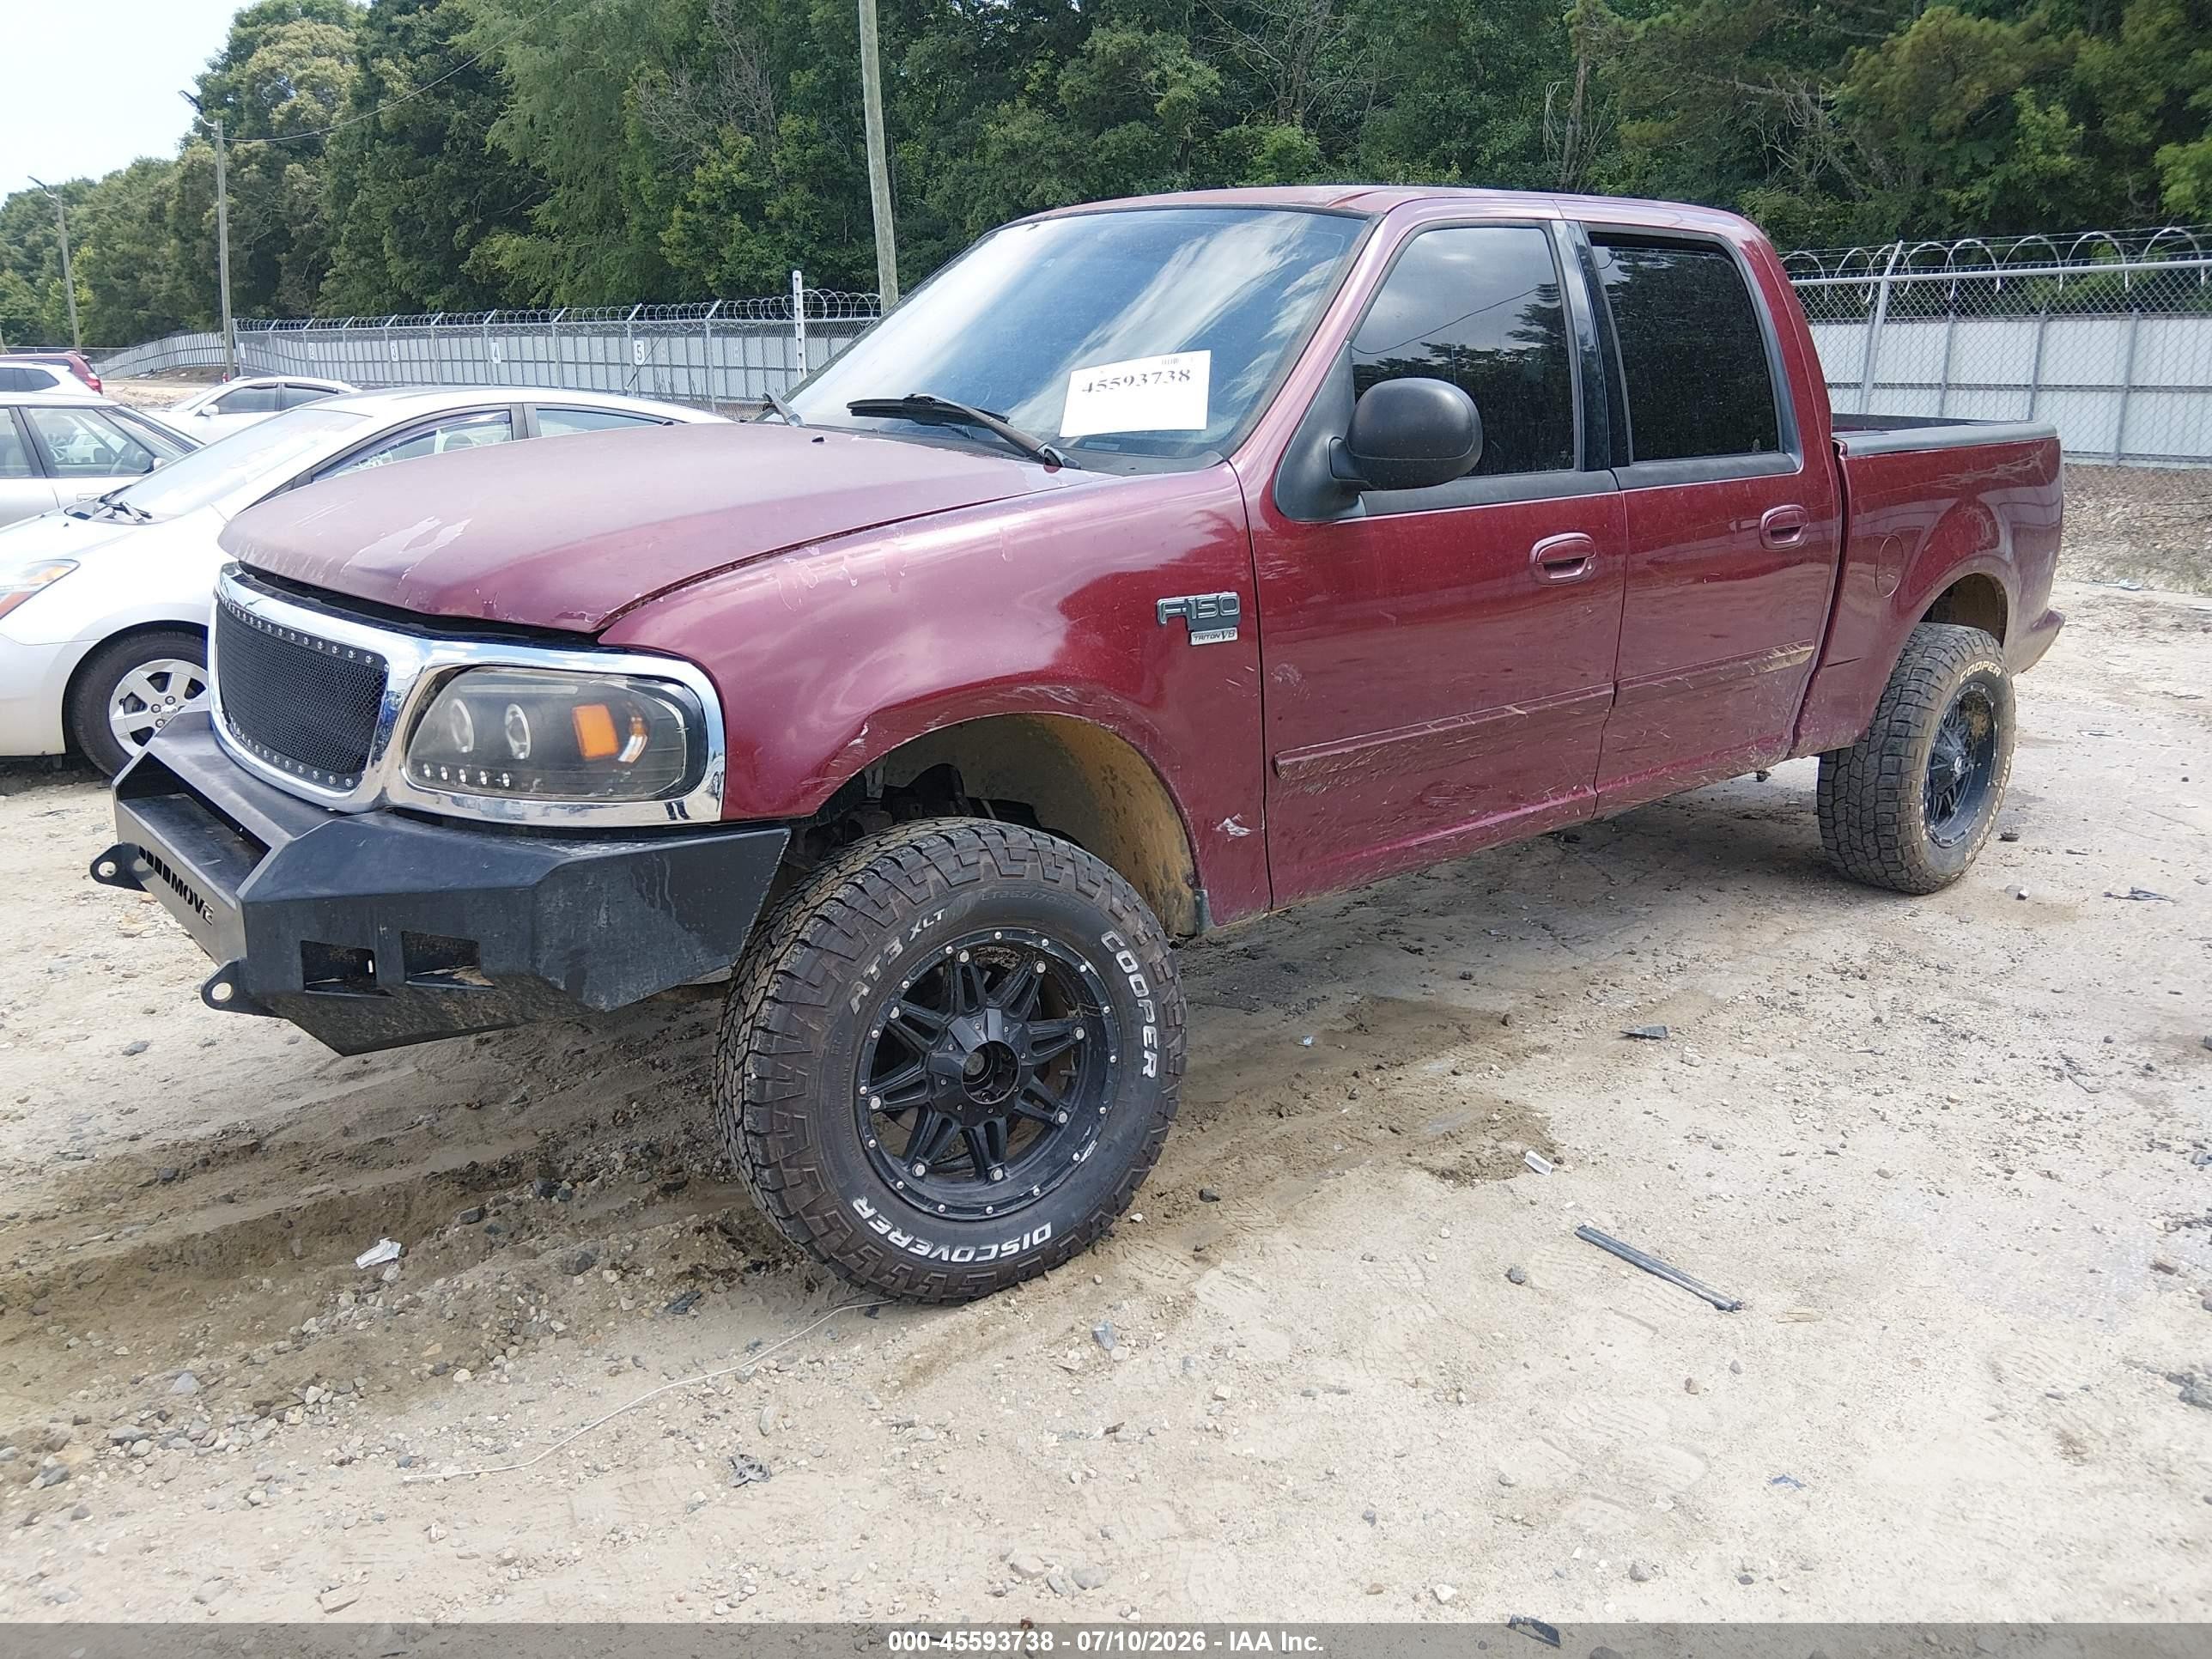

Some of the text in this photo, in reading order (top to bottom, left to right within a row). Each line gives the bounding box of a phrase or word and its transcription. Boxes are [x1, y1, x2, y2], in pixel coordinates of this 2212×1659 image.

[492, 345, 499, 359] 4
[636, 344, 642, 361] 5
[1082, 368, 1191, 393] 45593738
[1157, 592, 1240, 625] F-150
[1960, 660, 2002, 684] COOPER
[908, 908, 945, 942] XLT
[1101, 930, 1158, 1079] COOPER
[852, 1195, 1052, 1262] DISCOVERER
